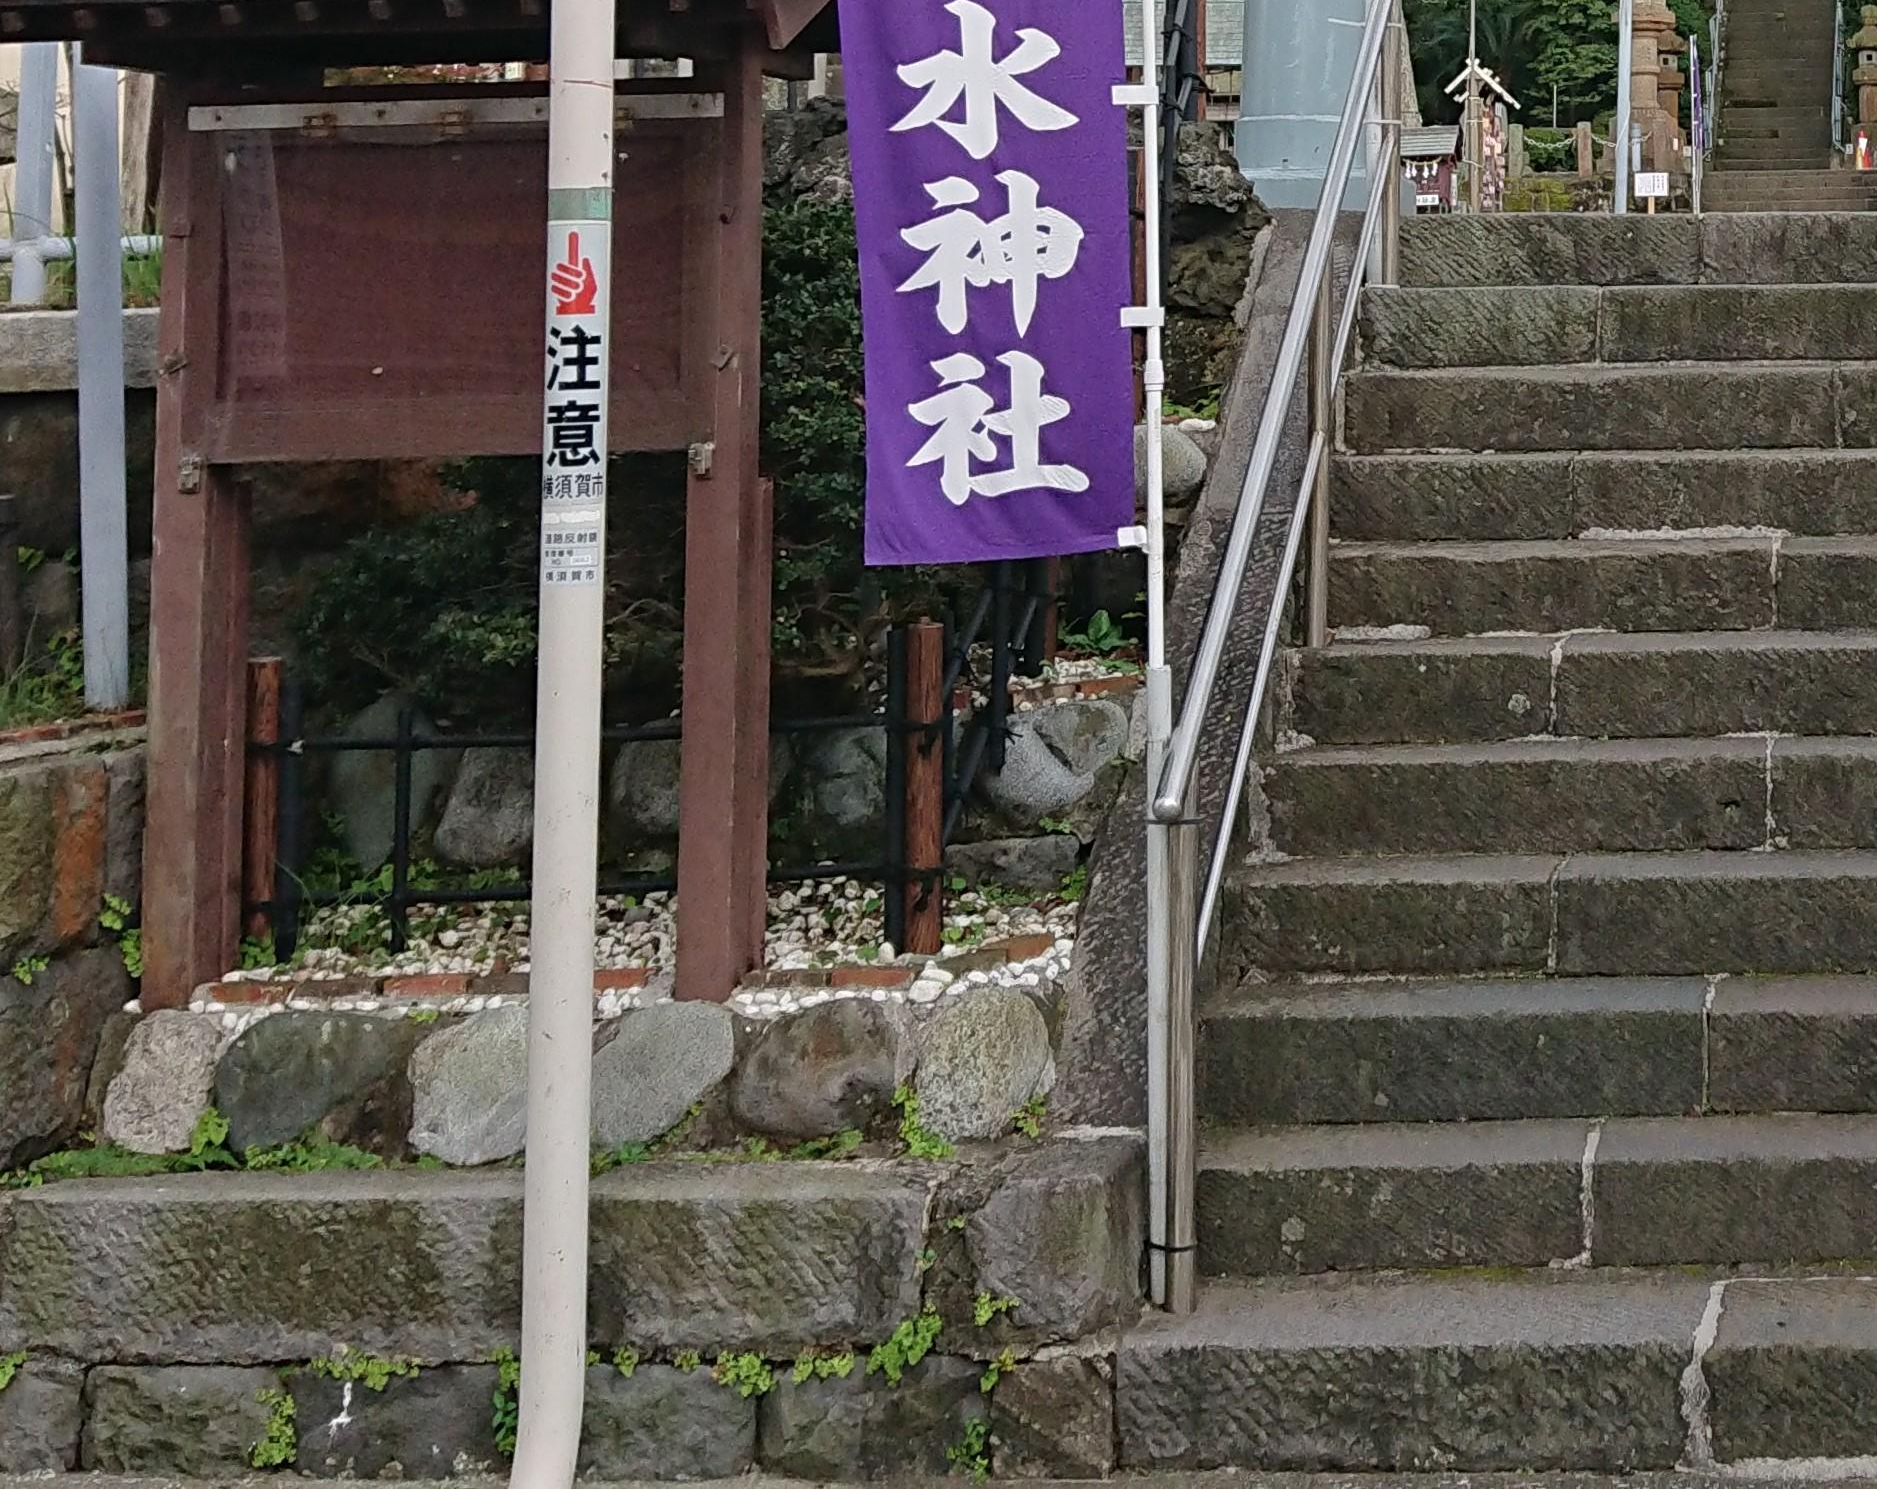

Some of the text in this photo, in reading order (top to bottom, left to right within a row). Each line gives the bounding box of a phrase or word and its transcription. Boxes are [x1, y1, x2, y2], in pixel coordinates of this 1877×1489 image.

[546, 325, 603, 468] 注意
[544, 472, 603, 499] 横須賀市
